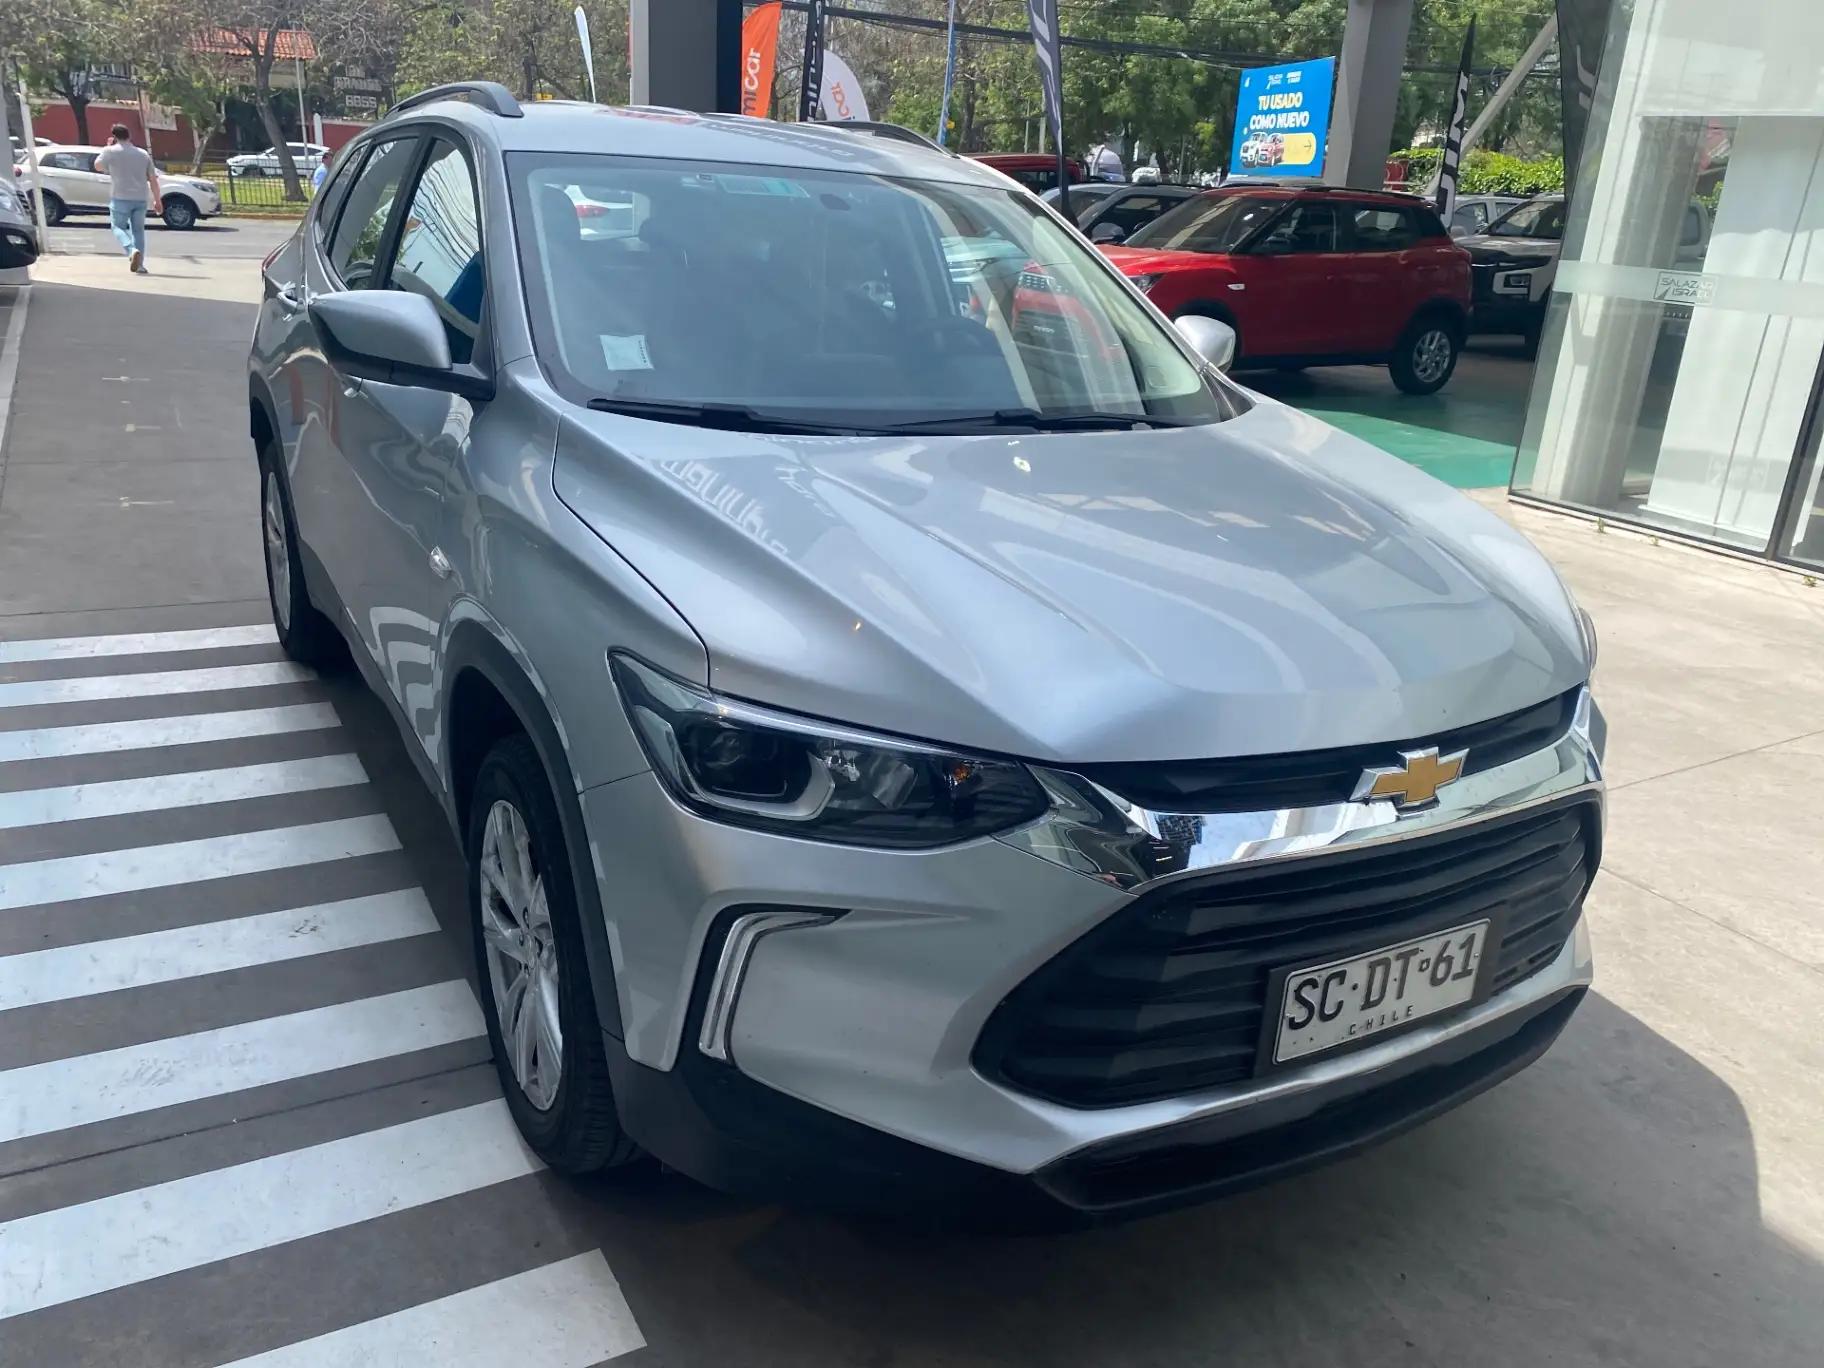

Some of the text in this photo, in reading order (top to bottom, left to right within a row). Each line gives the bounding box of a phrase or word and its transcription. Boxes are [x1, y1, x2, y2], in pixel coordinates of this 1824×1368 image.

[1258, 91, 1303, 110] TU USADO
[1249, 111, 1310, 130] COMO NUEVO
[1349, 1005, 1414, 1036] CHILE
